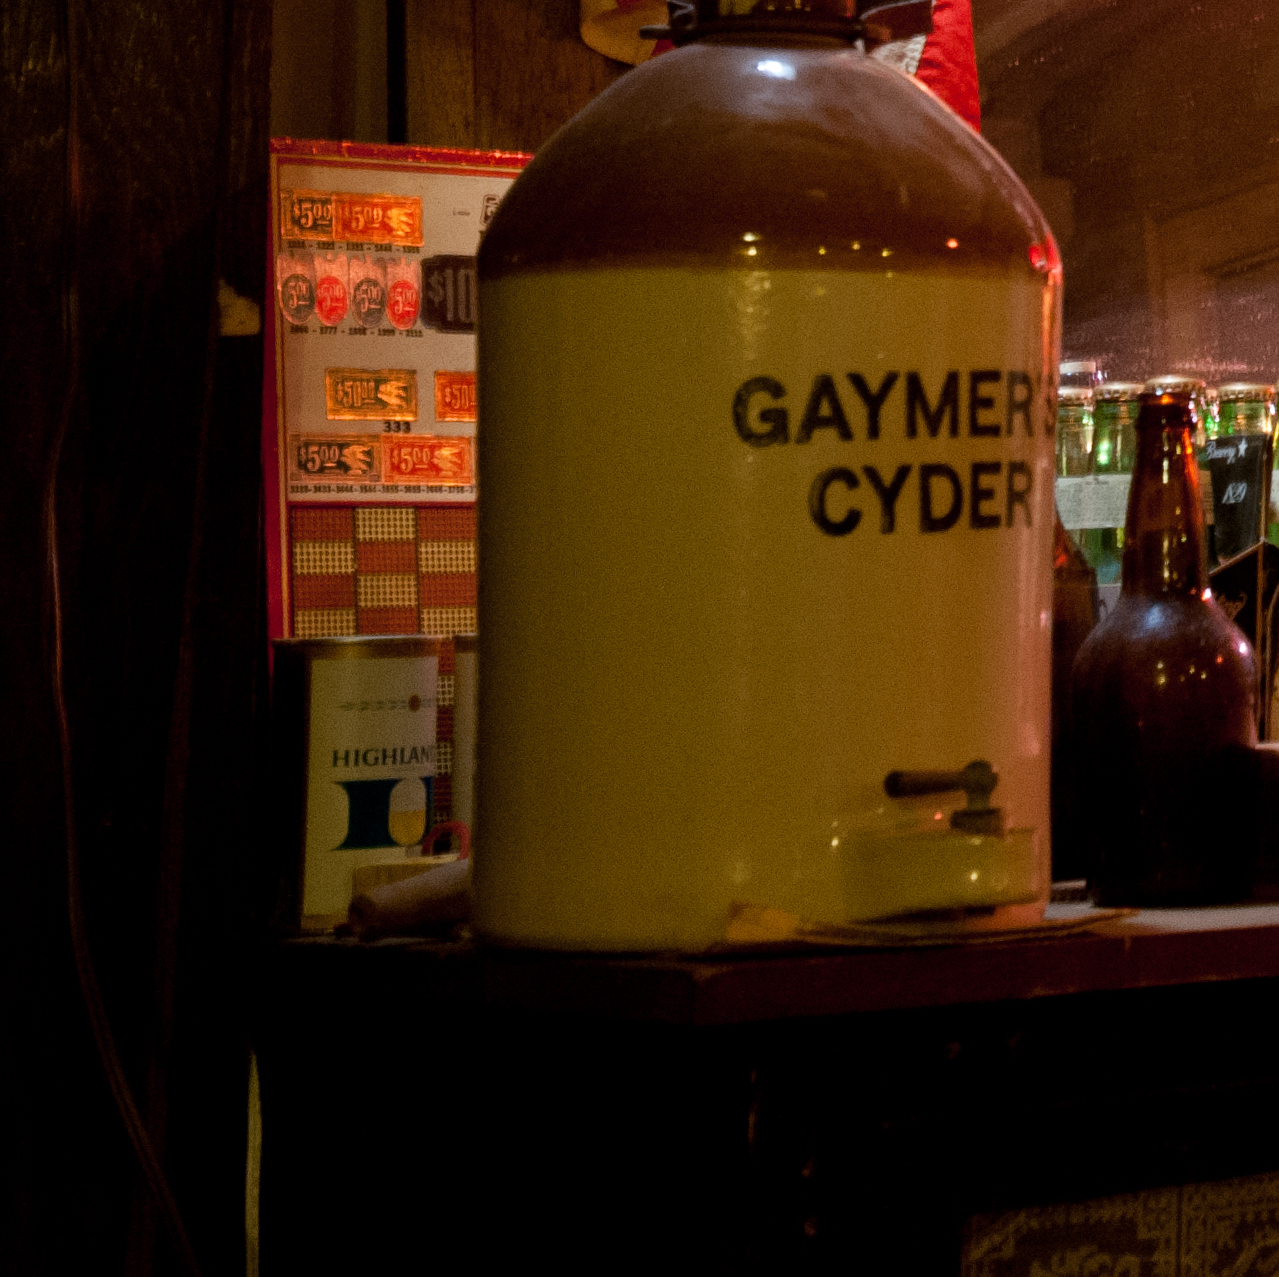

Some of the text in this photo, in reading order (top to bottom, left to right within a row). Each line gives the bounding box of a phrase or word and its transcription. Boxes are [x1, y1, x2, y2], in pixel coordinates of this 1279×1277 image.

[384, 421, 411, 433] 333
[807, 461, 1034, 537] CYDER
[332, 745, 437, 767] HIGHLAN
